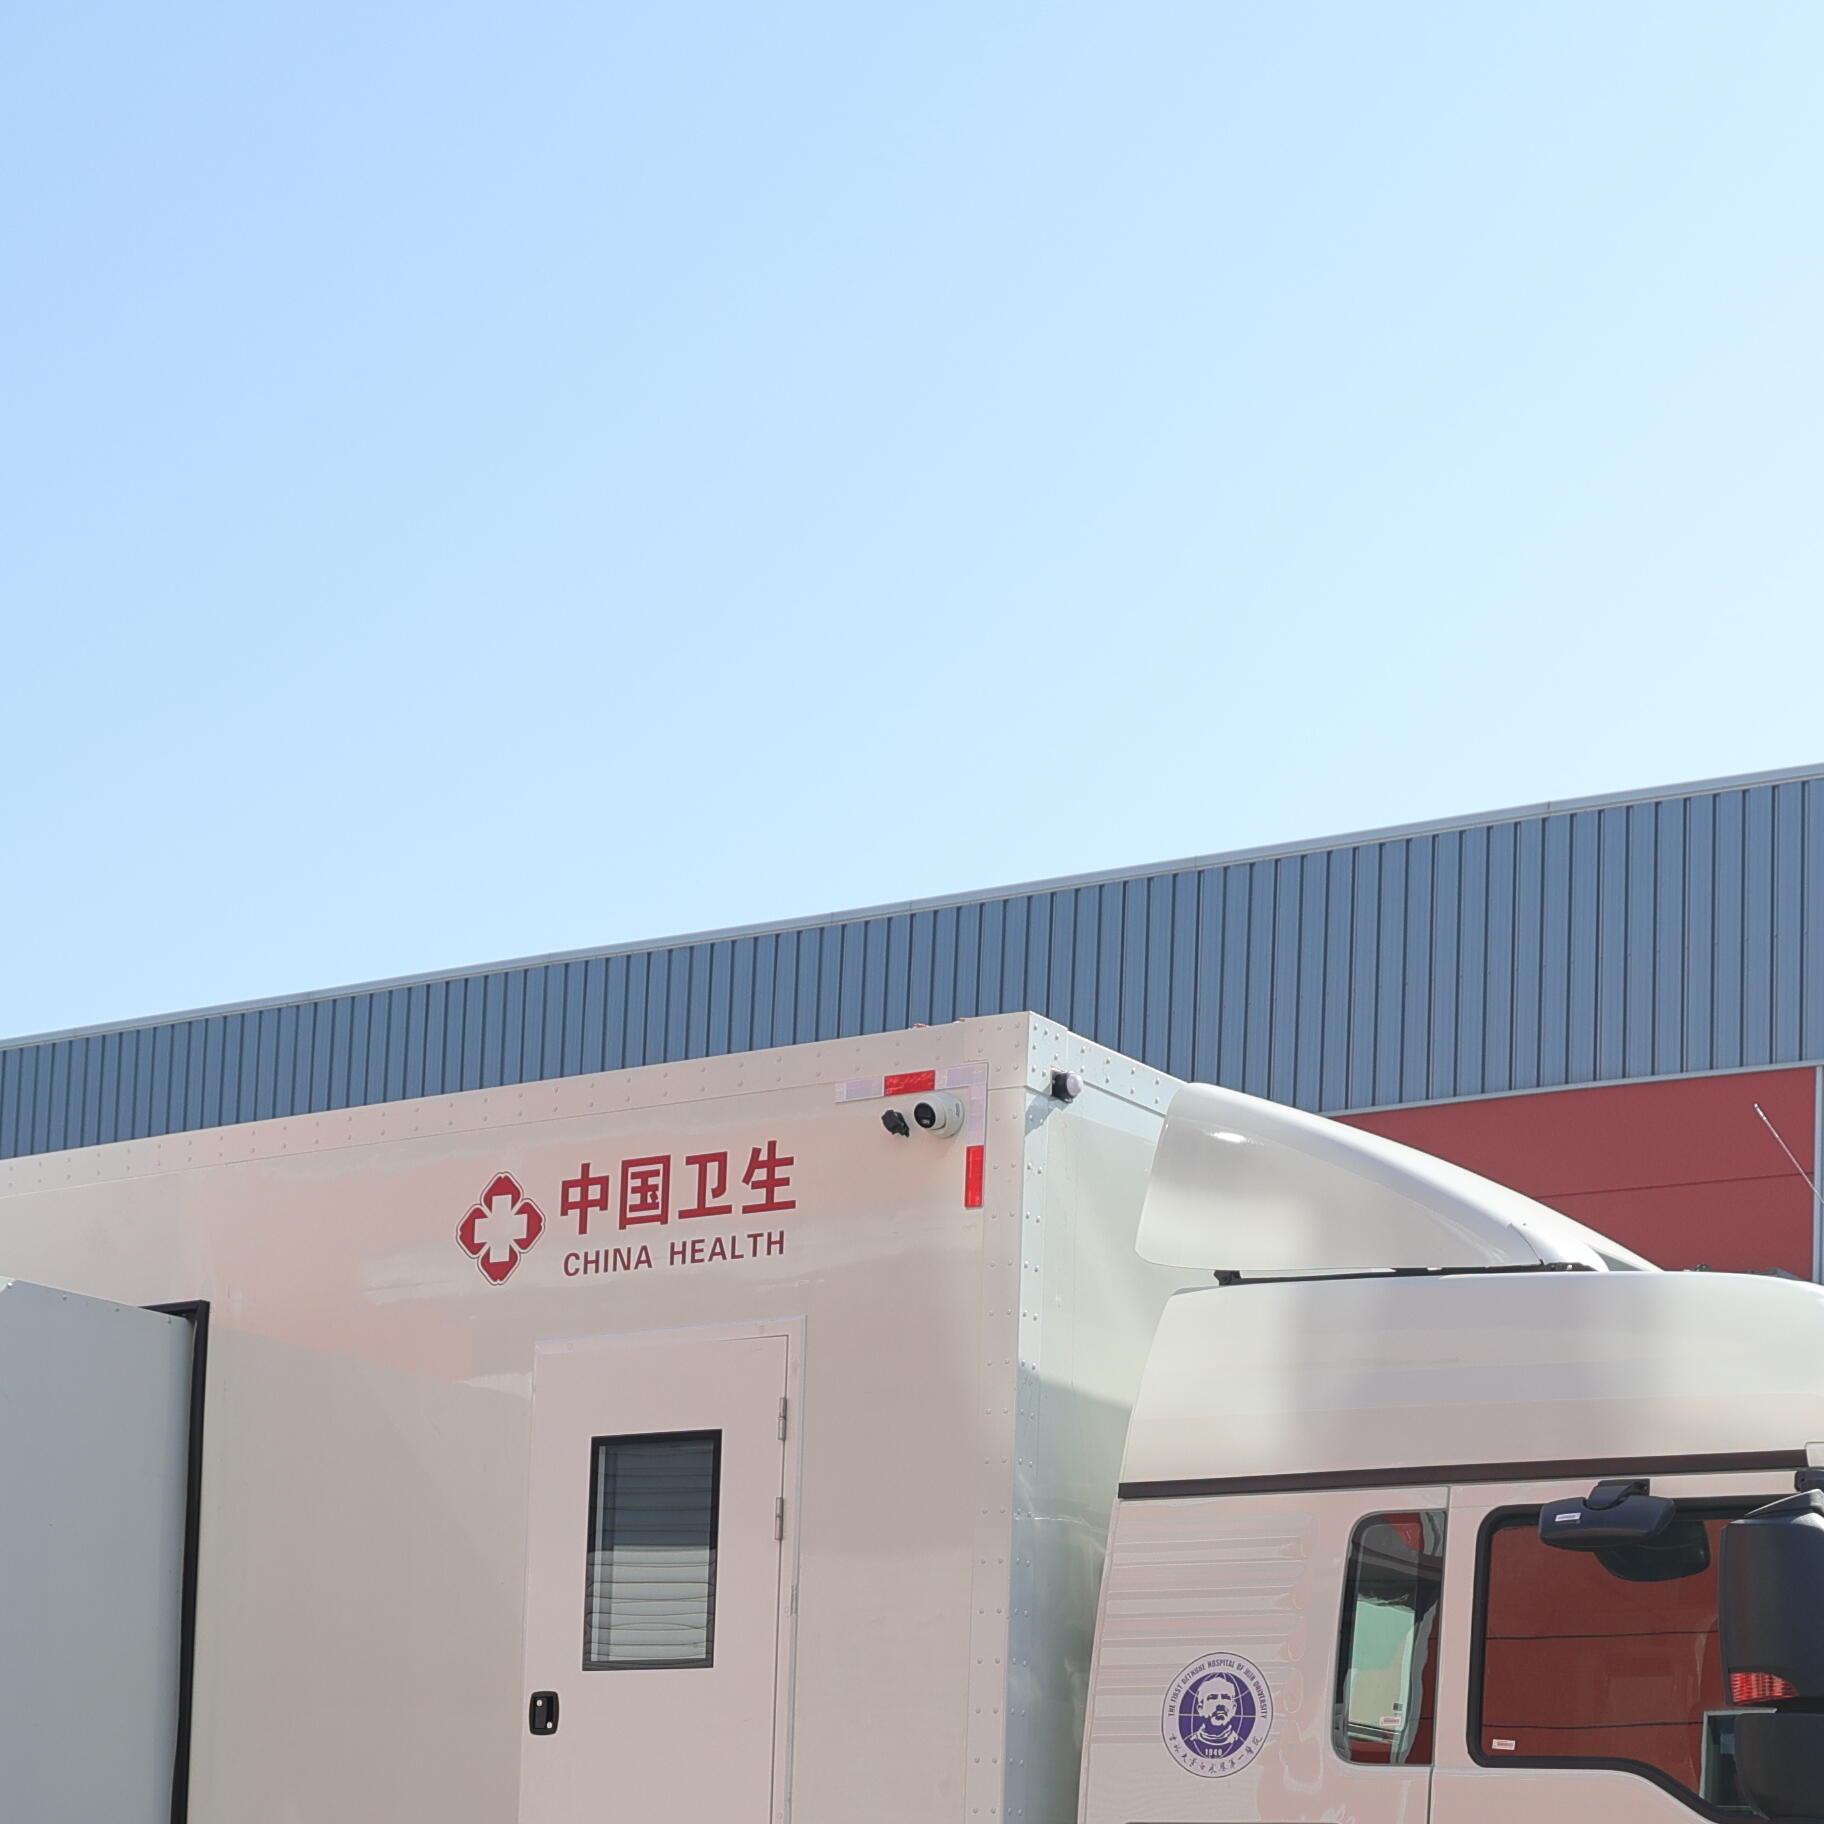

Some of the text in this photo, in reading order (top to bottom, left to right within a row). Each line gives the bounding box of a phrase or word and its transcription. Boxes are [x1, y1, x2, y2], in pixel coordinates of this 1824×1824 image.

[559, 1139, 797, 1236] 中国卫生
[563, 1230, 785, 1277] CHINA HEALTH
